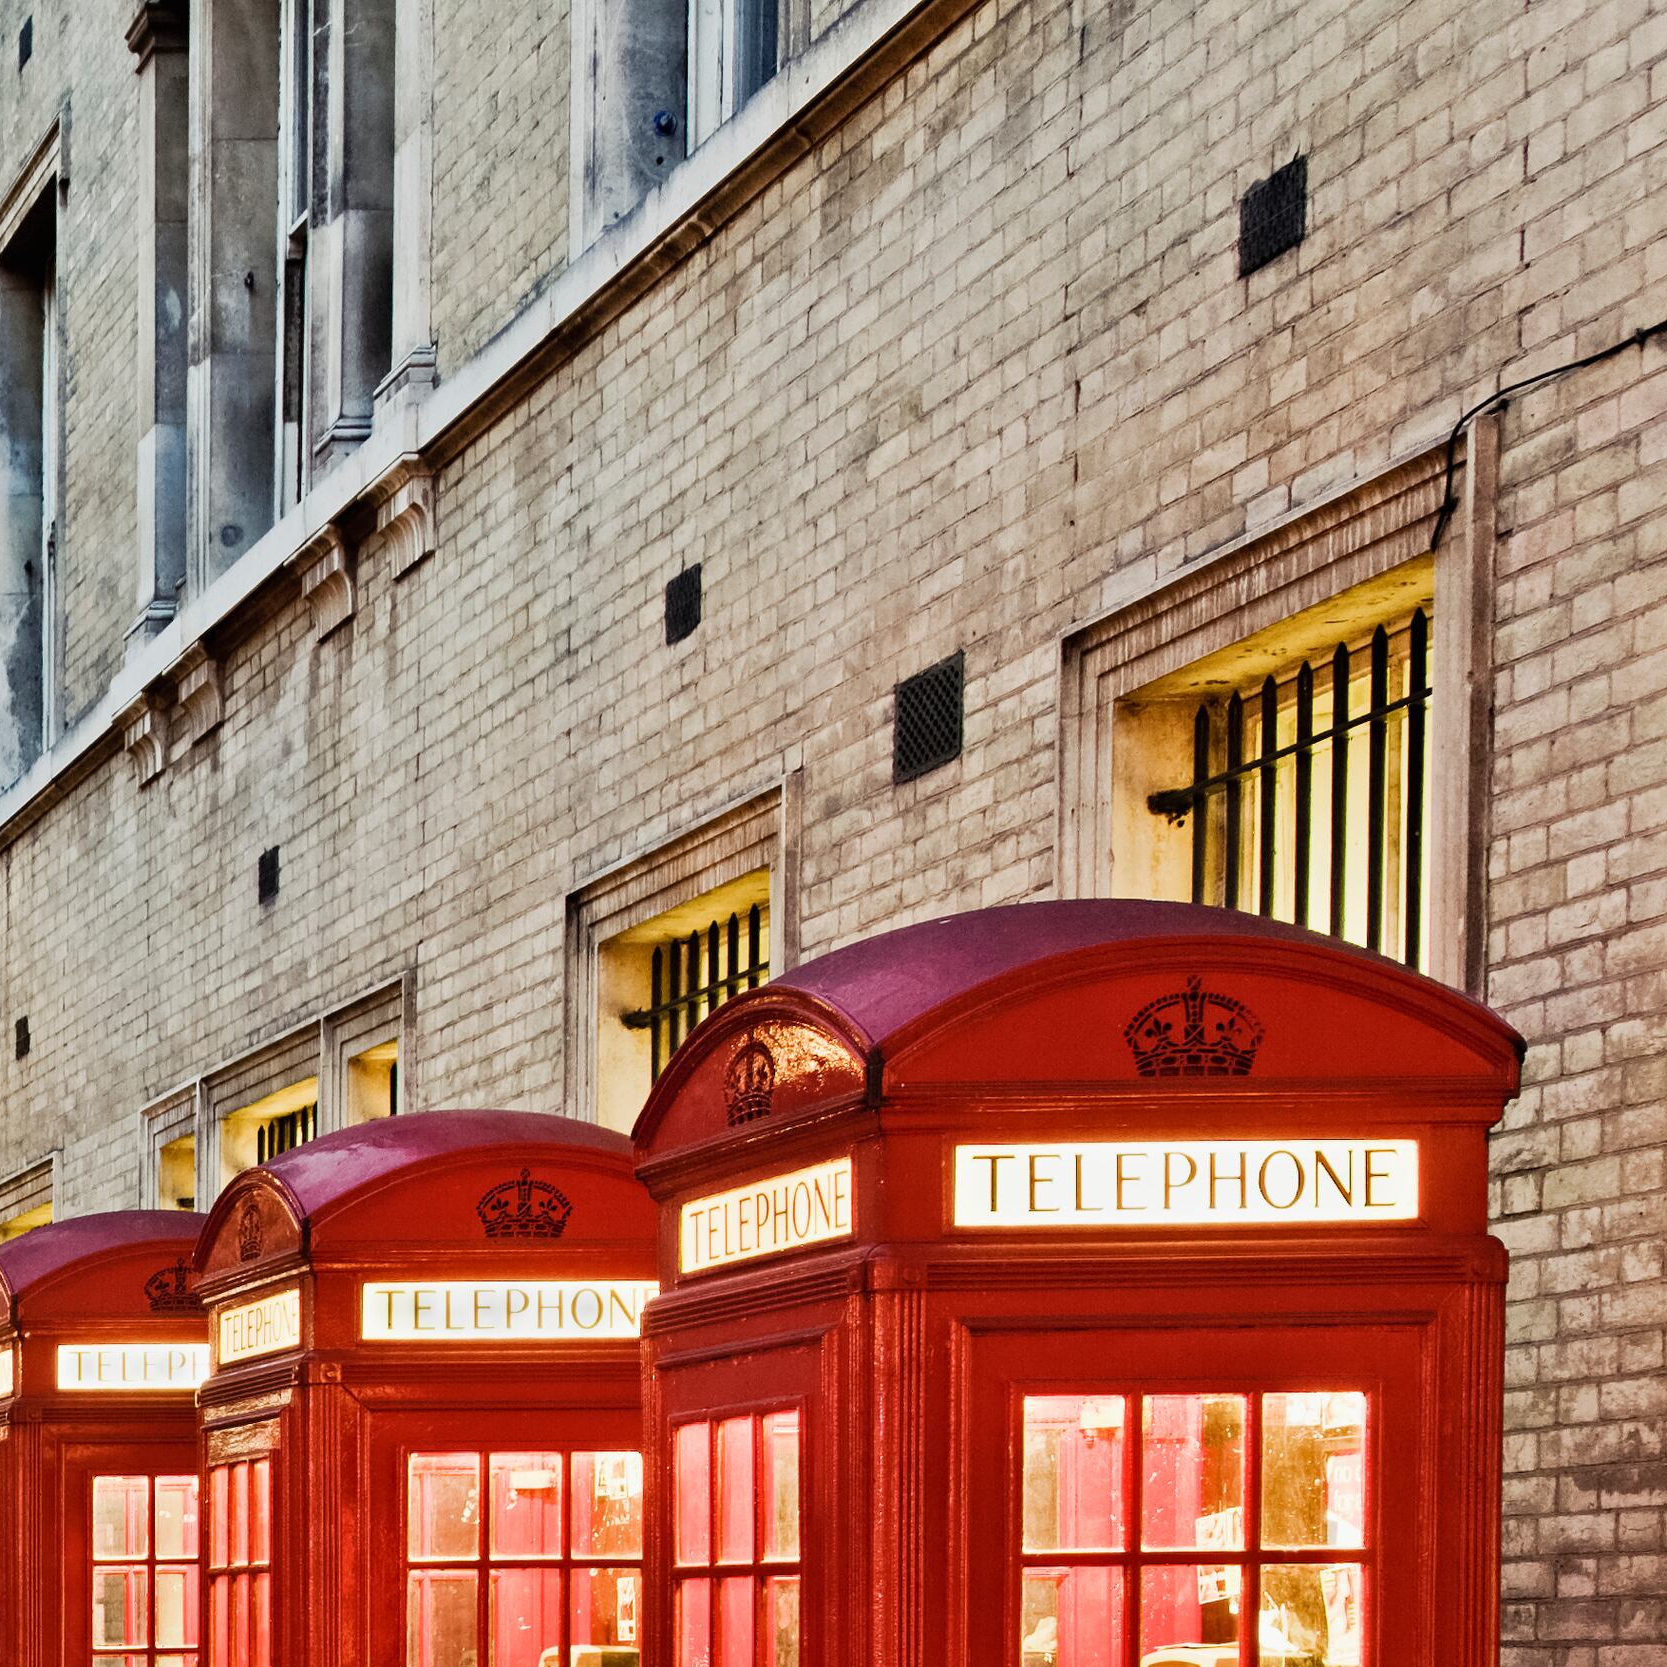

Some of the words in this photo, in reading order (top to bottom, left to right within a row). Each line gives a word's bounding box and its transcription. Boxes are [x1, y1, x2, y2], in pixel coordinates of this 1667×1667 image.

[972, 1149, 1398, 1213] TELEPHONE
[689, 1170, 849, 1264] TELEPHONE
[224, 1296, 300, 1355] TELEPHONE
[68, 1351, 211, 1382] TELEPH
